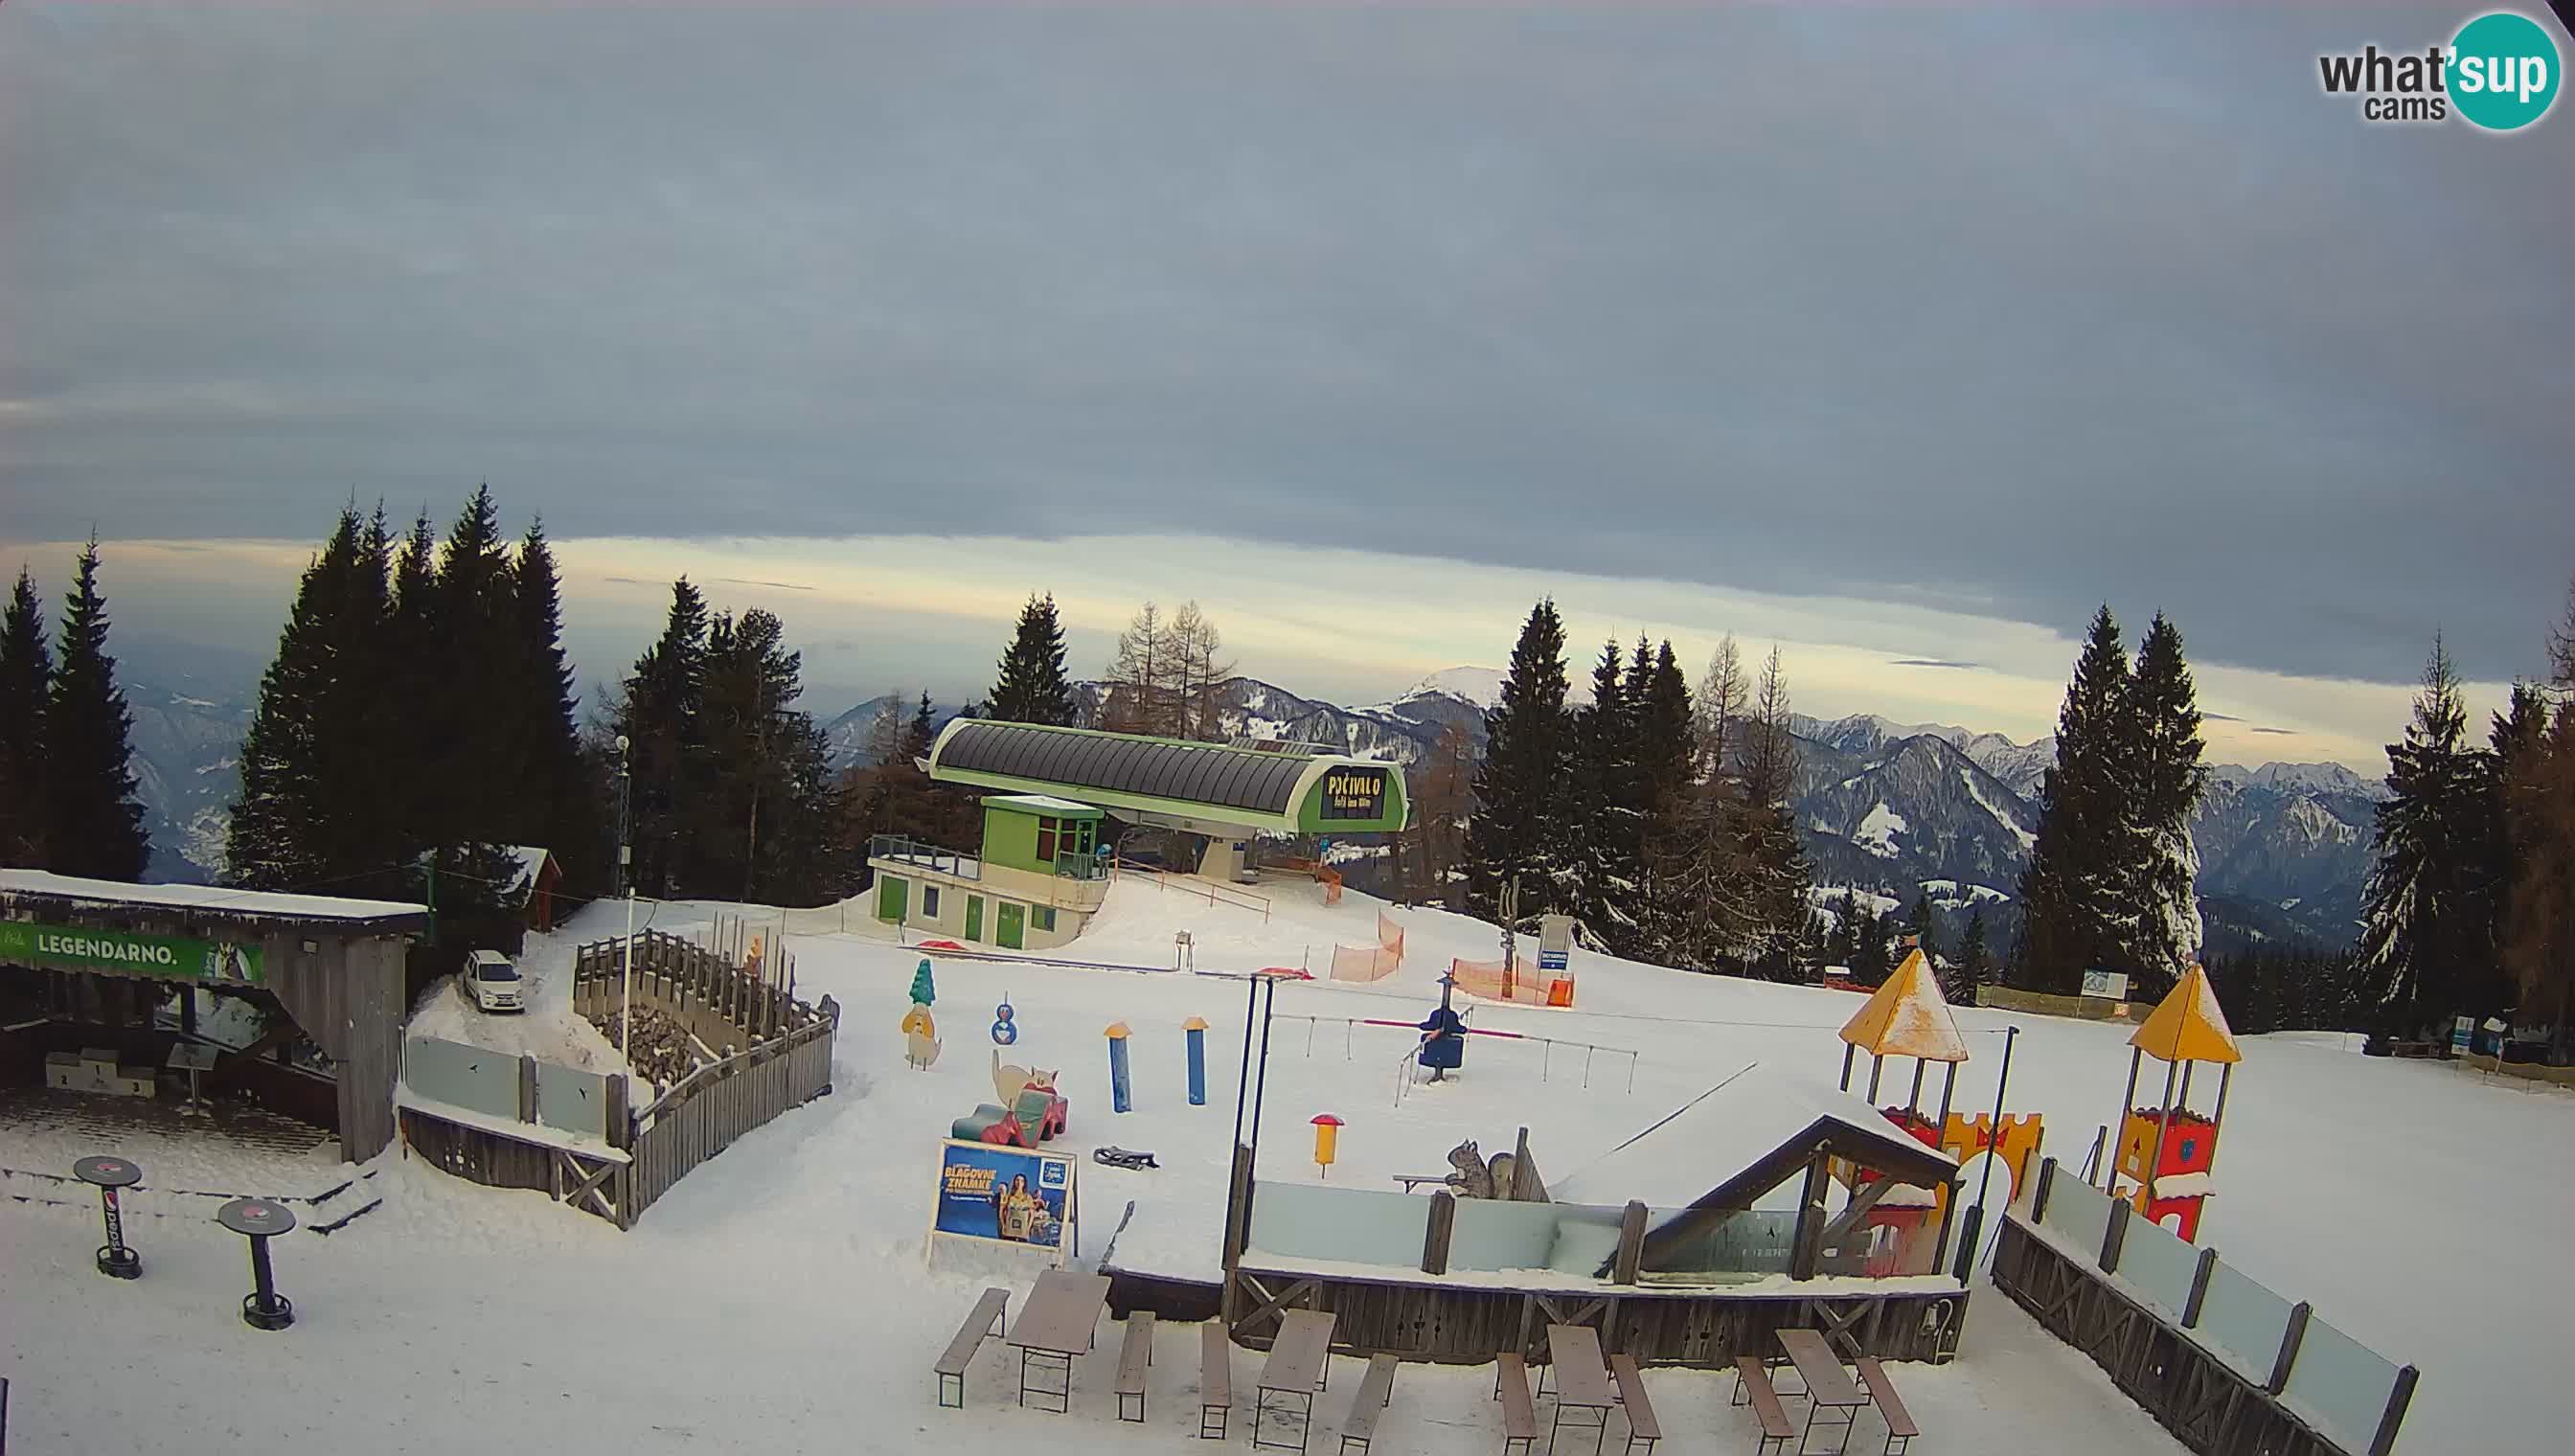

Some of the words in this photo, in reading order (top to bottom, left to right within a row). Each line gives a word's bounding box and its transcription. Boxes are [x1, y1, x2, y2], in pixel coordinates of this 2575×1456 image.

[38, 934, 178, 966] LEGENDARNO.
[61, 1075, 68, 1085] 2
[132, 1081, 141, 1092] 3
[106, 1212, 123, 1251] pepsi
